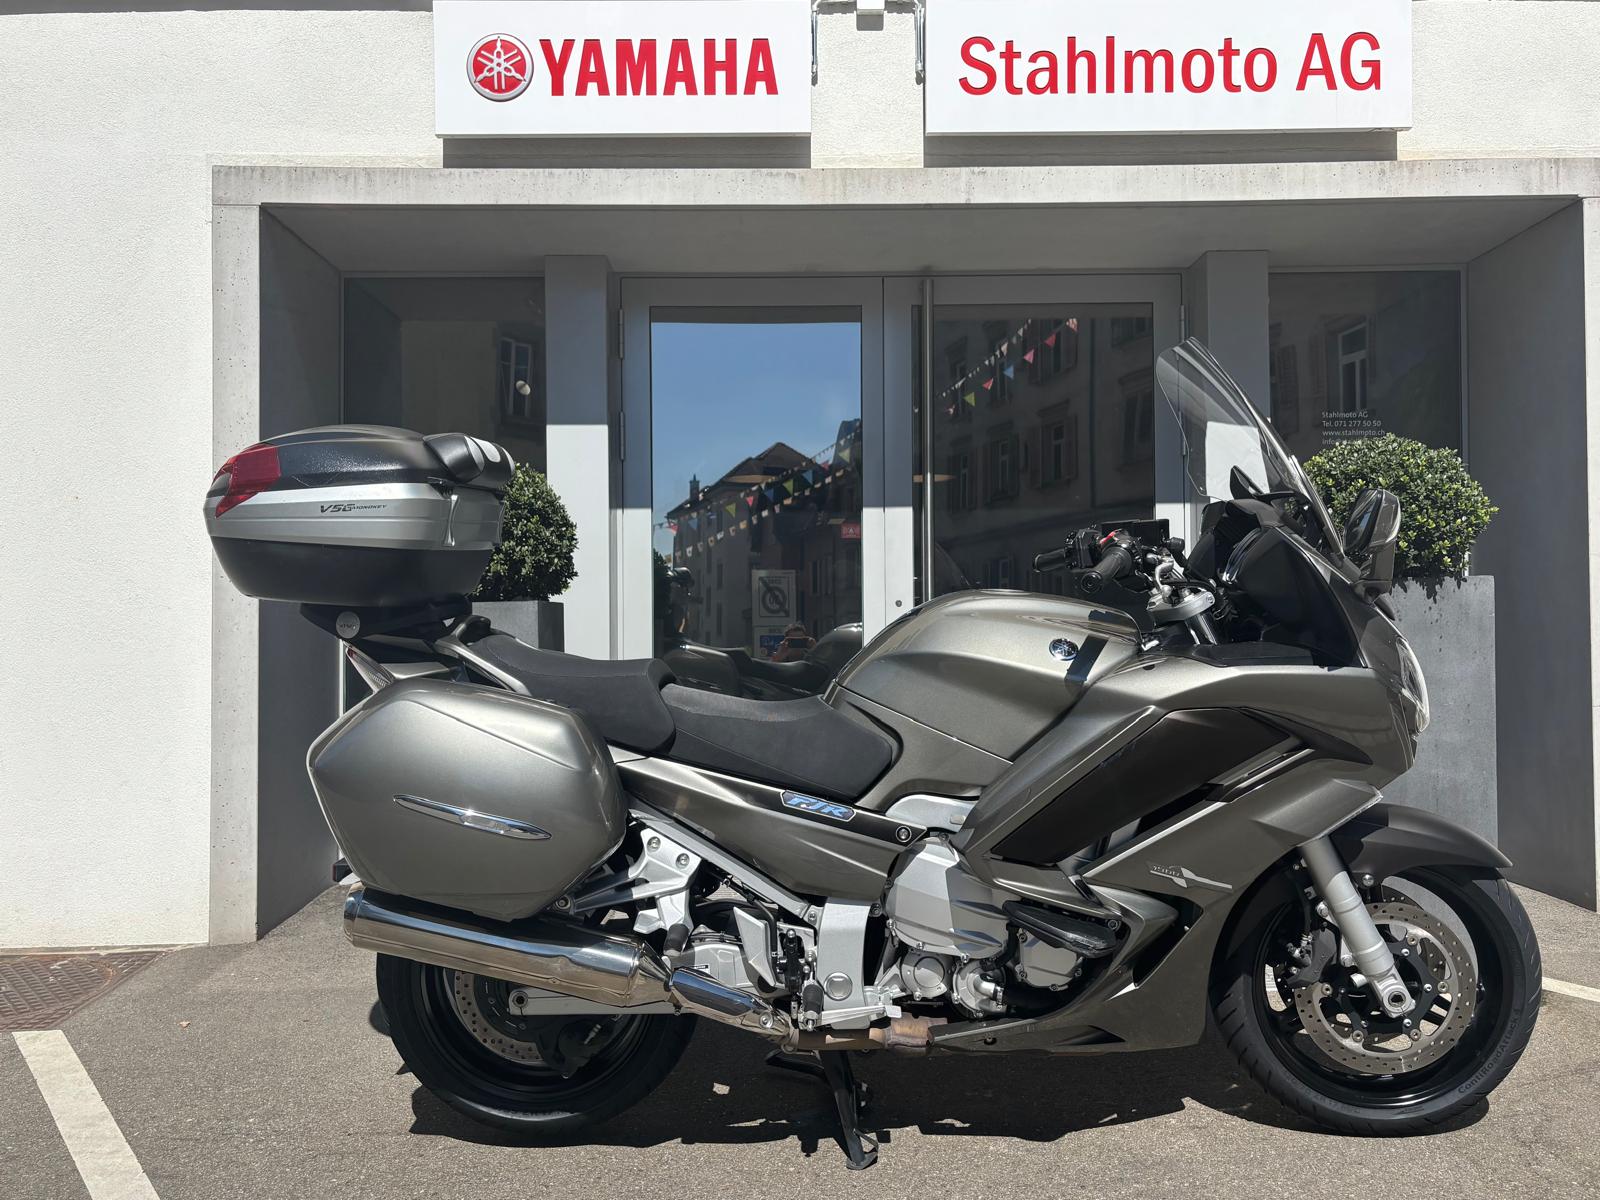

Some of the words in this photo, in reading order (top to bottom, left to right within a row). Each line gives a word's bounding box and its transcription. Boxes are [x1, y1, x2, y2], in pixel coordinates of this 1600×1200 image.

[539, 38, 778, 96] YAMAHA
[958, 35, 1278, 95] Stahlmoto
[1296, 31, 1382, 91] AG
[786, 793, 849, 817] FJR
